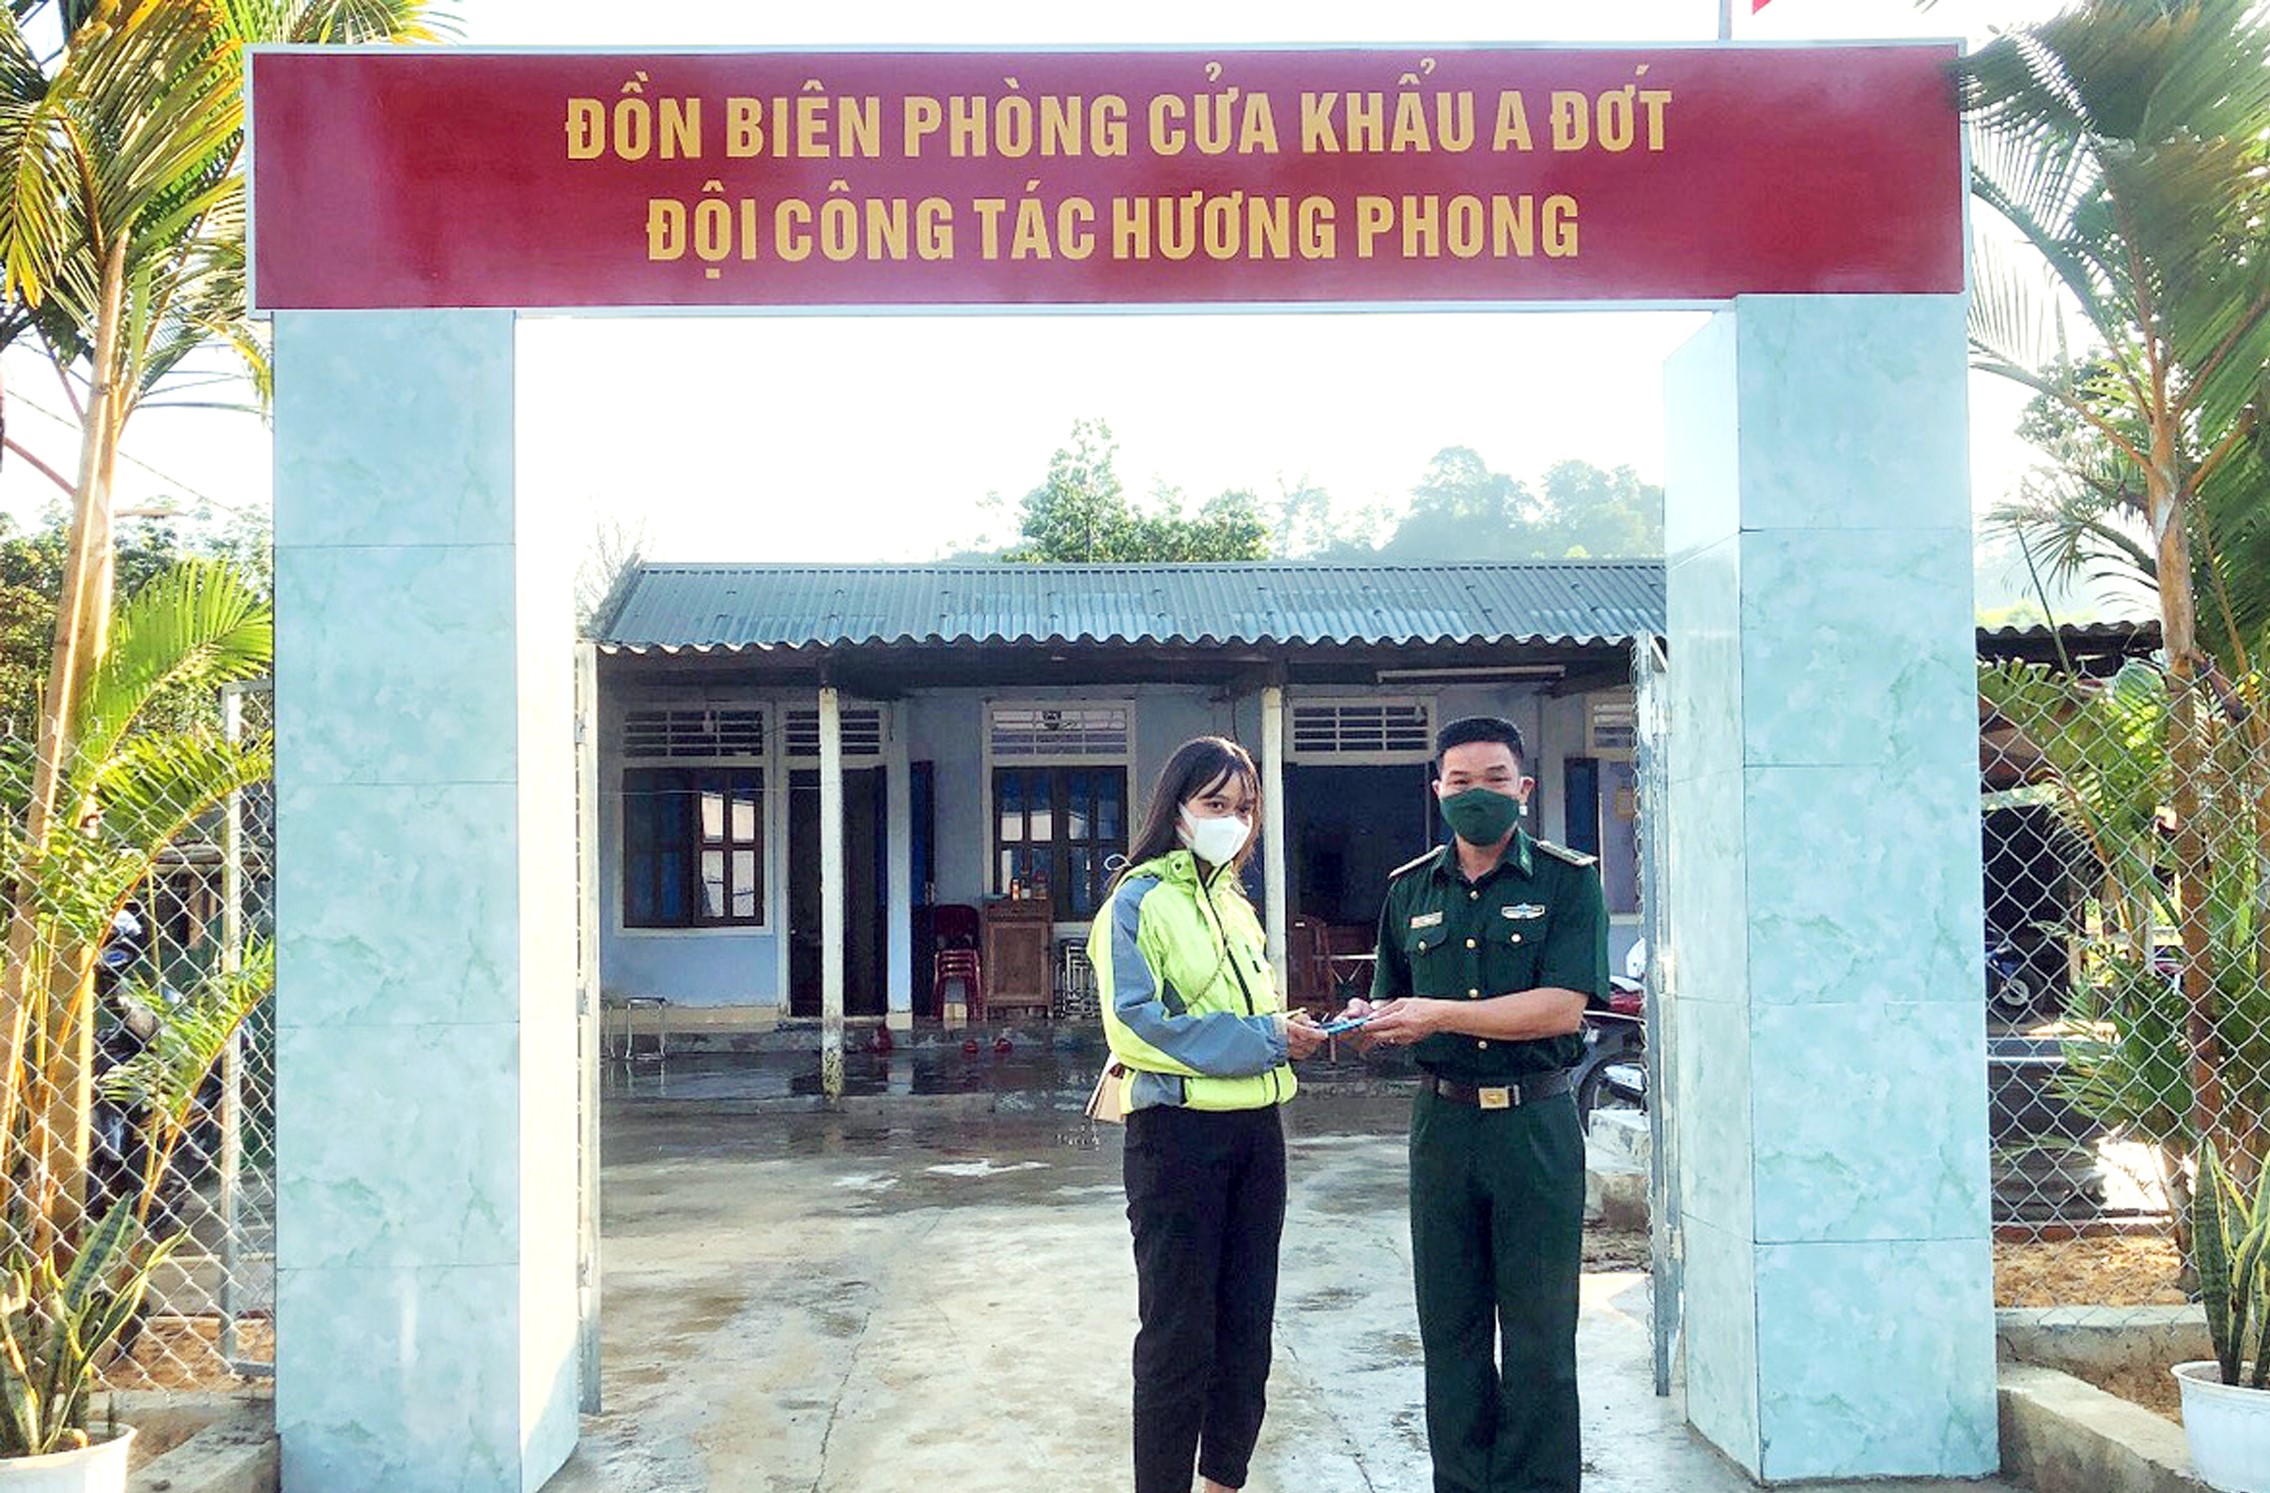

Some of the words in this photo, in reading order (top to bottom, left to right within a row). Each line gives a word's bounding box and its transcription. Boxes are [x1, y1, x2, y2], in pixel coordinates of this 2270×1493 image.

[565, 71, 702, 161] ĐỒN
[726, 78, 881, 158] BIÊN
[903, 76, 1128, 159] PHÒNG
[1148, 62, 1280, 156] CỬA
[1300, 56, 1476, 154] KHẨU
[1491, 91, 1534, 152] A
[1549, 64, 1673, 152] ĐỚT
[646, 179, 758, 280] ĐỘI
[774, 179, 955, 263] CÔNG
[972, 179, 1096, 263] TÁC
[1112, 190, 1337, 261] HƯƠNG
[1356, 194, 1579, 260] PHONG
